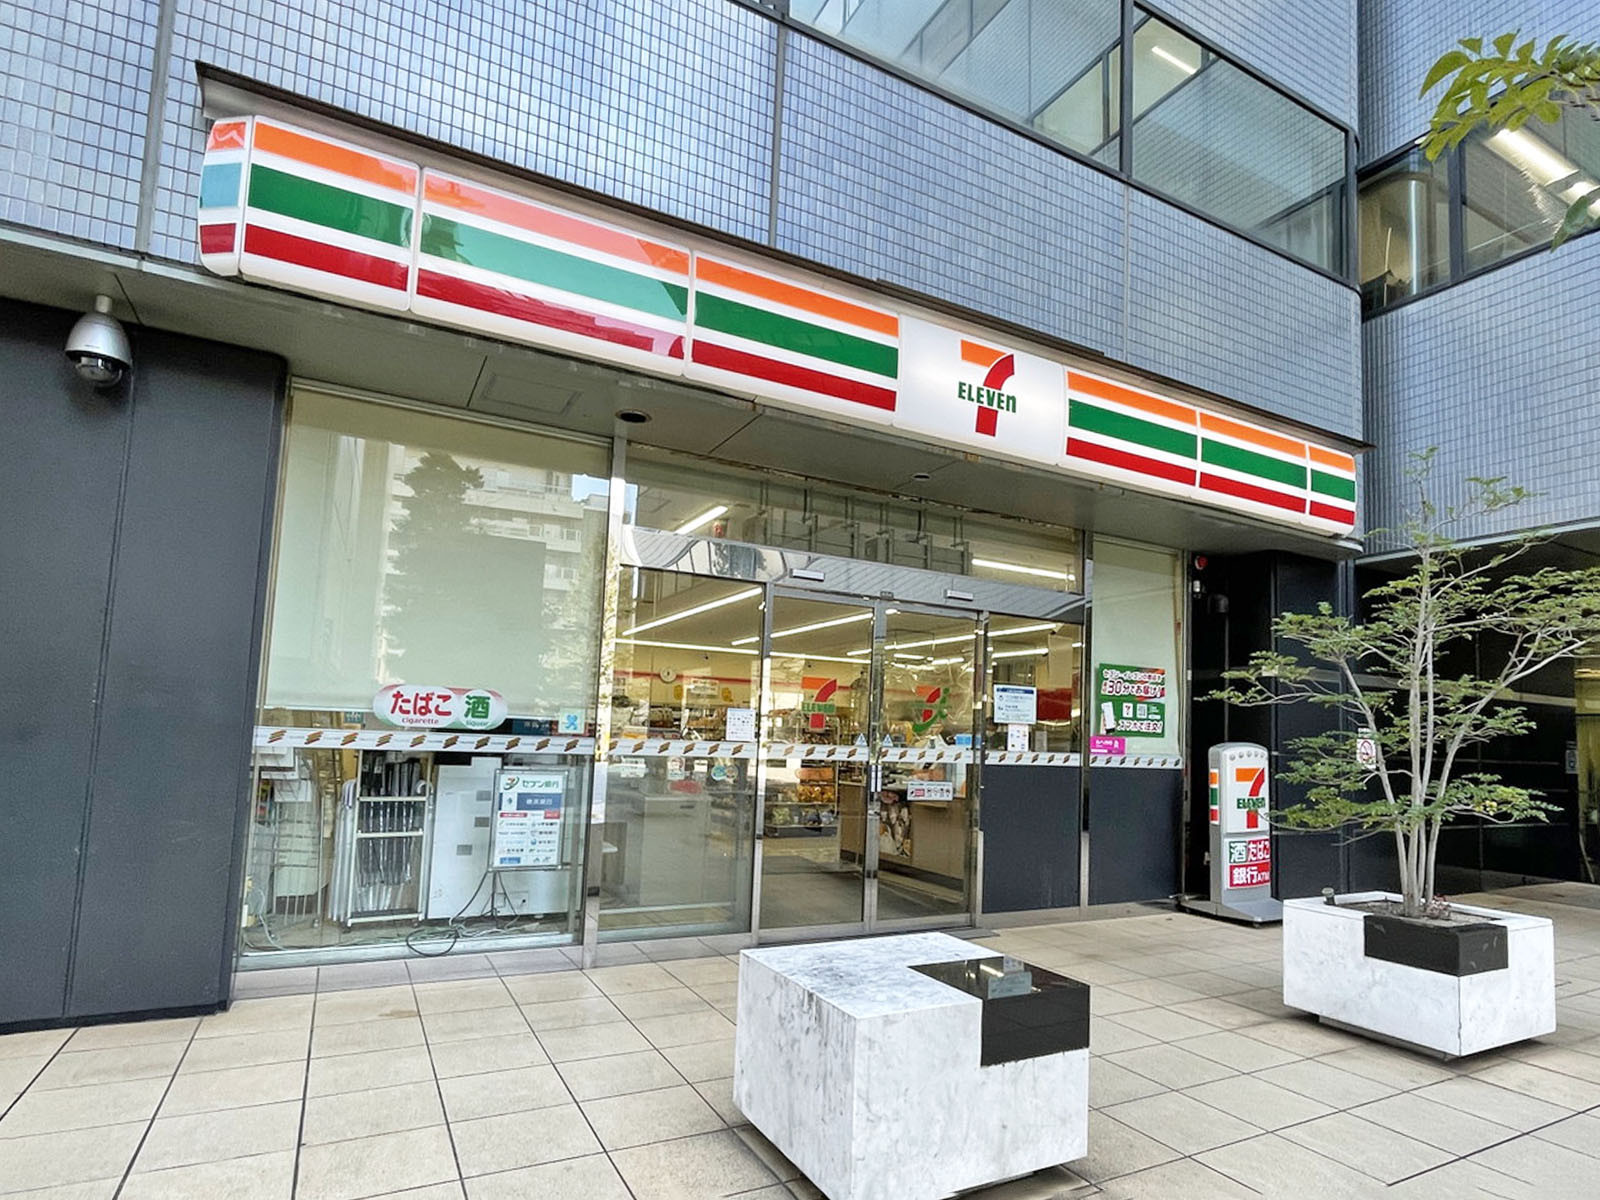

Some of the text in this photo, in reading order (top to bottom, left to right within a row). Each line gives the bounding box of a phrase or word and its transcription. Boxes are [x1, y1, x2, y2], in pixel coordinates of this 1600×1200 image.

[961, 339, 1015, 437] 7
[390, 690, 491, 719] たばこ 酒
[1235, 767, 1265, 829] 7
[1230, 841, 1270, 863] 酒 たばこ
